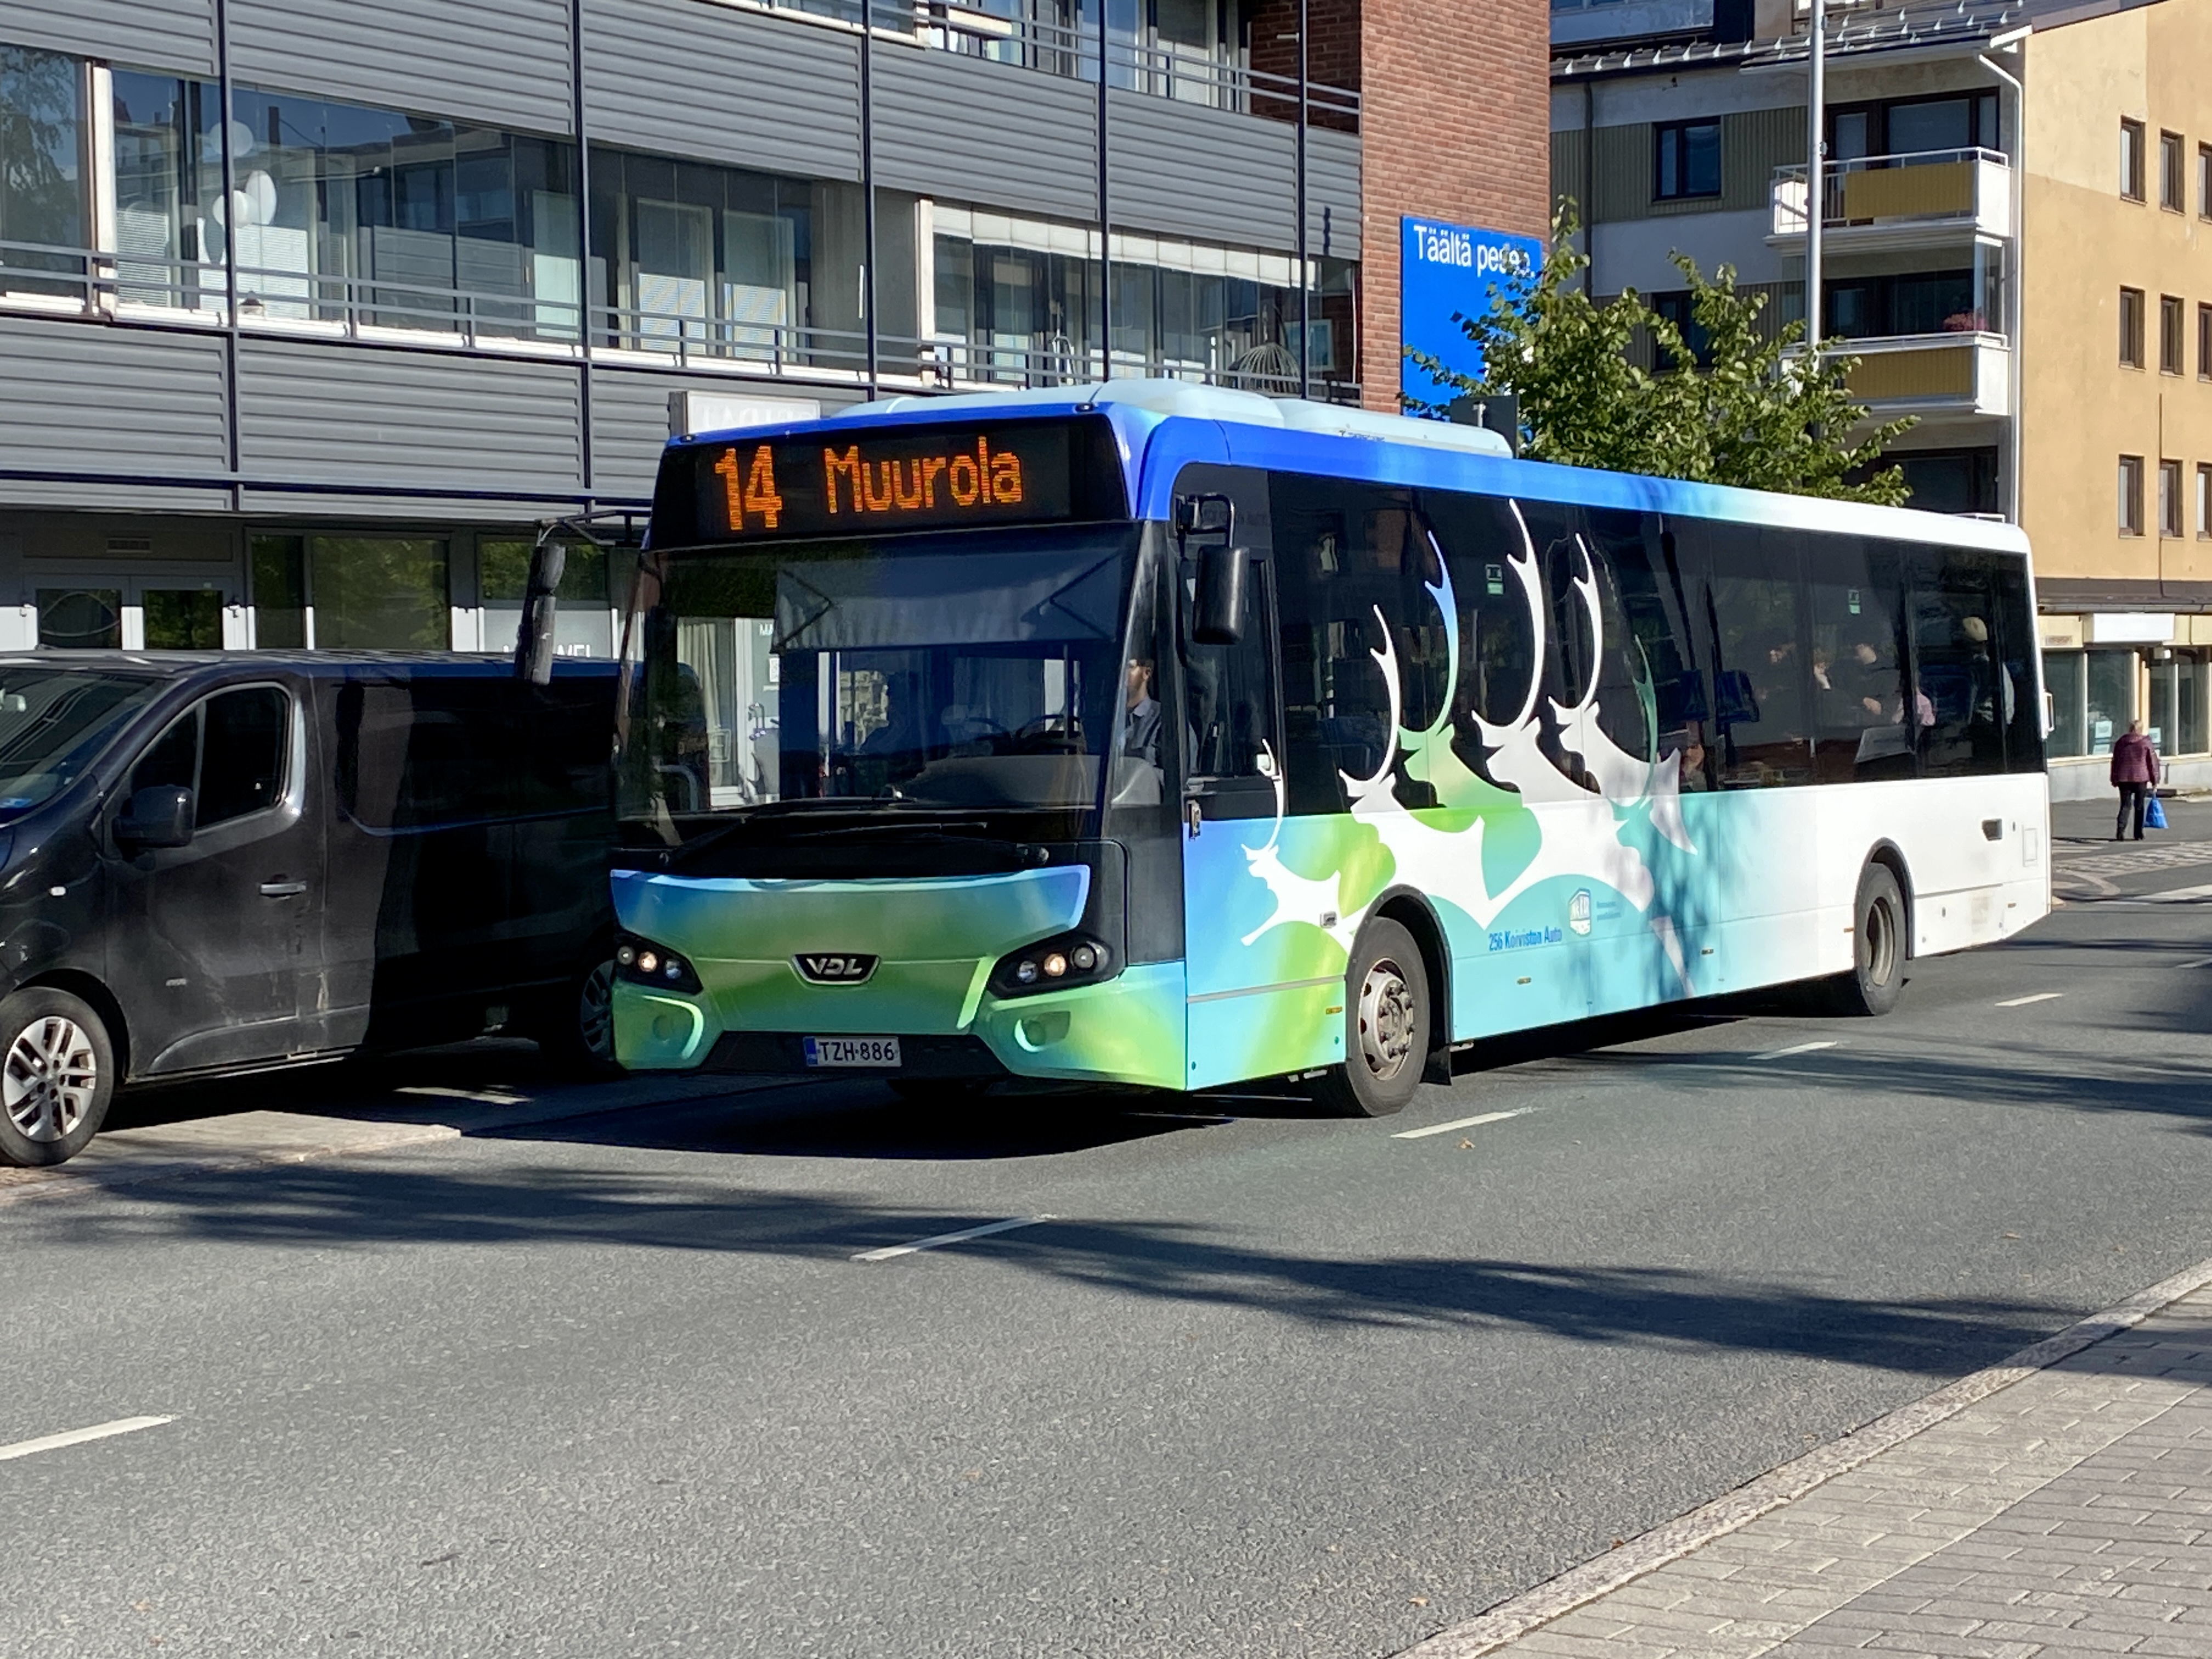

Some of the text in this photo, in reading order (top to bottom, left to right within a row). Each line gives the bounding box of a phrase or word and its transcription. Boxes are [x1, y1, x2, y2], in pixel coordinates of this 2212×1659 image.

[1413, 224, 1472, 268] Täältä
[714, 436, 1023, 531] 14 Muurola
[1488, 932, 1504, 952] 256
[1543, 925, 1563, 944] Auto
[806, 958, 863, 975] VDL
[819, 1041, 894, 1062] TZH-886
